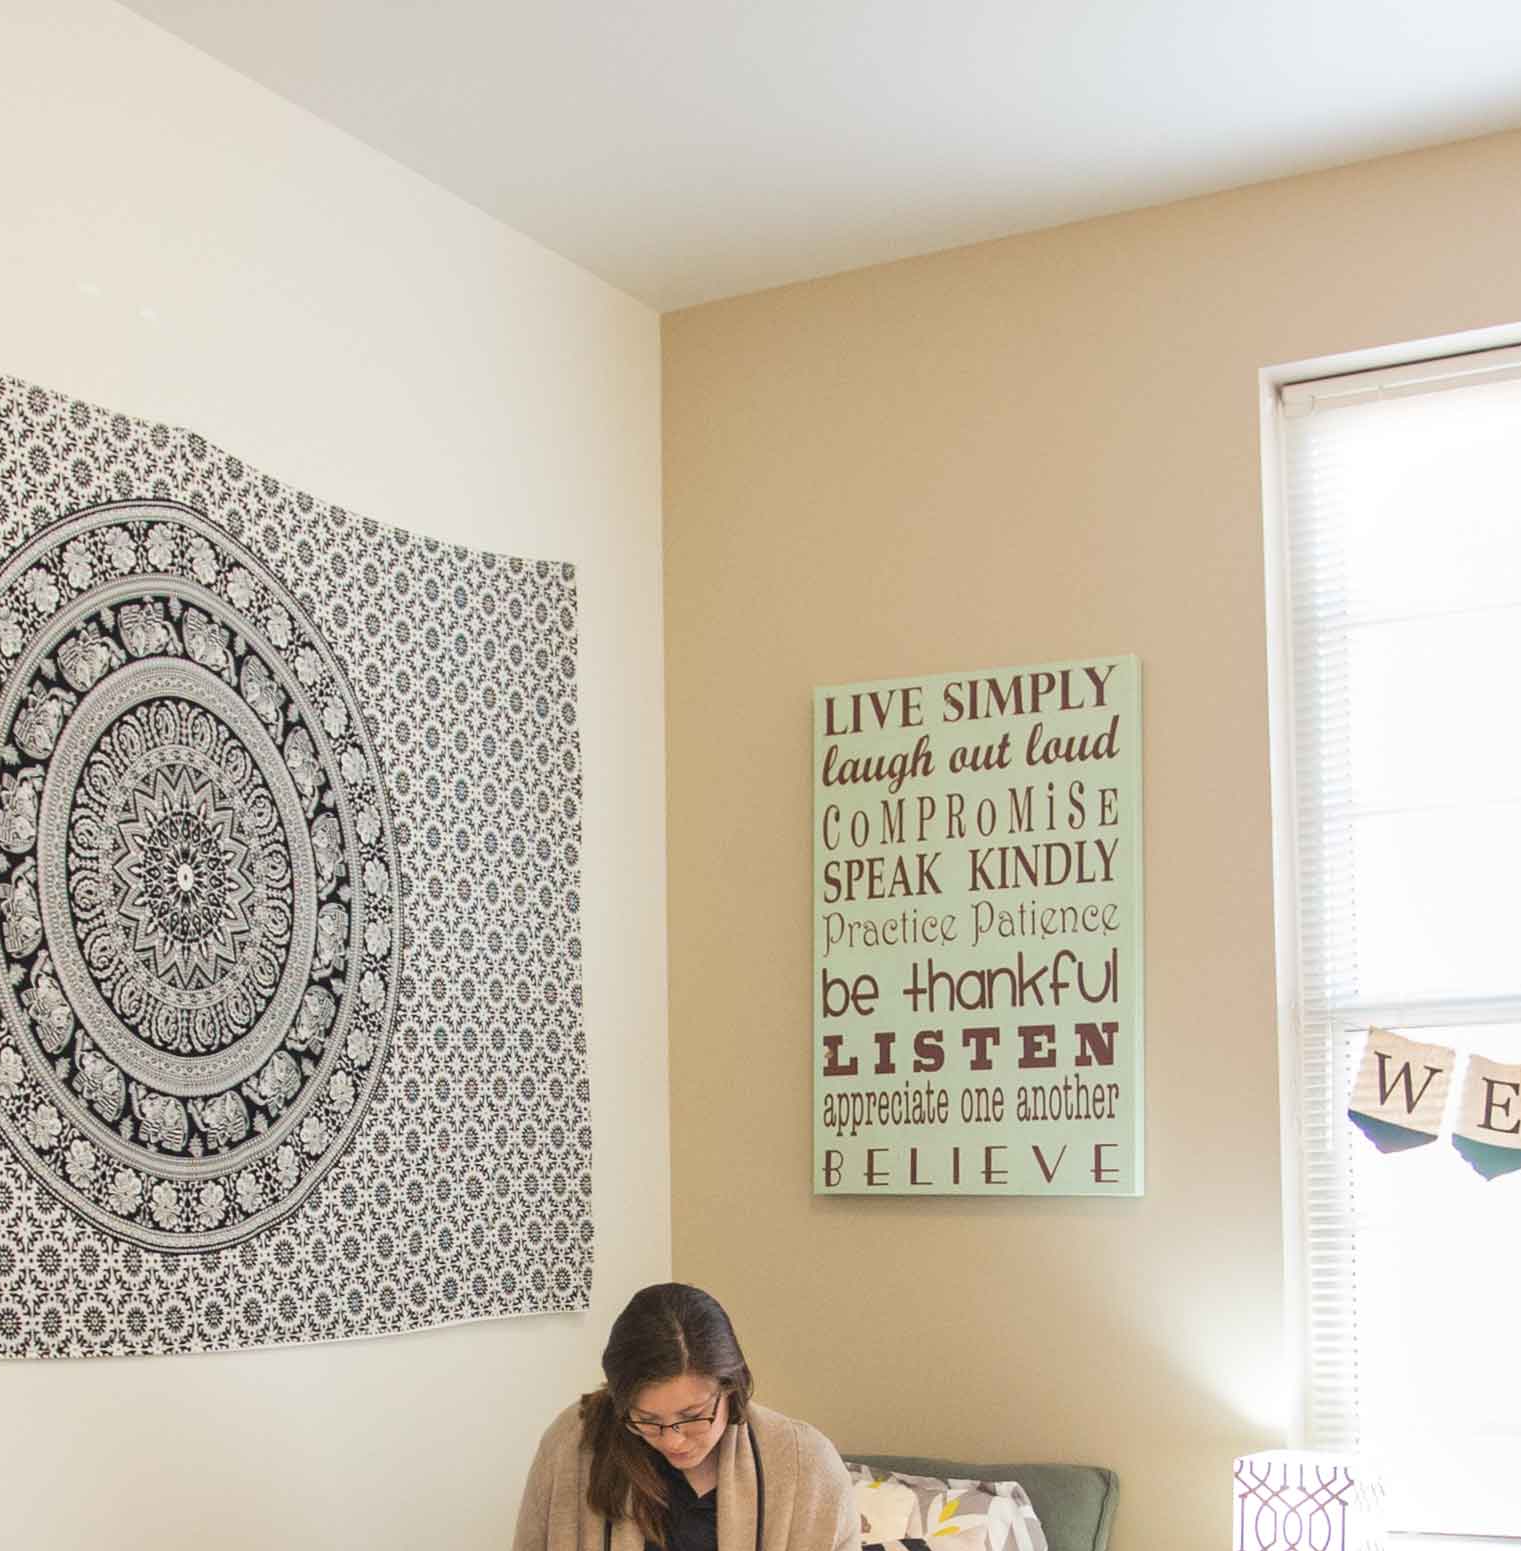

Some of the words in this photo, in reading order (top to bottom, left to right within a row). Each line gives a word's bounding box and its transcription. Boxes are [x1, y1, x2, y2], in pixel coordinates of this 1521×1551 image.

[824, 687, 924, 736] LIVE
[942, 665, 1118, 722] SIMPLY
[823, 735, 935, 793] laugh
[949, 735, 1012, 774] out
[1026, 715, 1120, 766] loud
[824, 851, 943, 903] SPEAK
[968, 838, 1118, 892] KINDLY
[824, 910, 957, 957] Practice
[971, 901, 1118, 946] Patience
[823, 968, 878, 1018] be
[903, 947, 1118, 1013] thankful
[823, 1022, 1118, 1076] LISTEN
[823, 1079, 949, 1137] appreciate
[961, 1089, 1004, 1123] one
[1016, 1074, 1118, 1122] another
[822, 1144, 1118, 1187] BELIEVE
